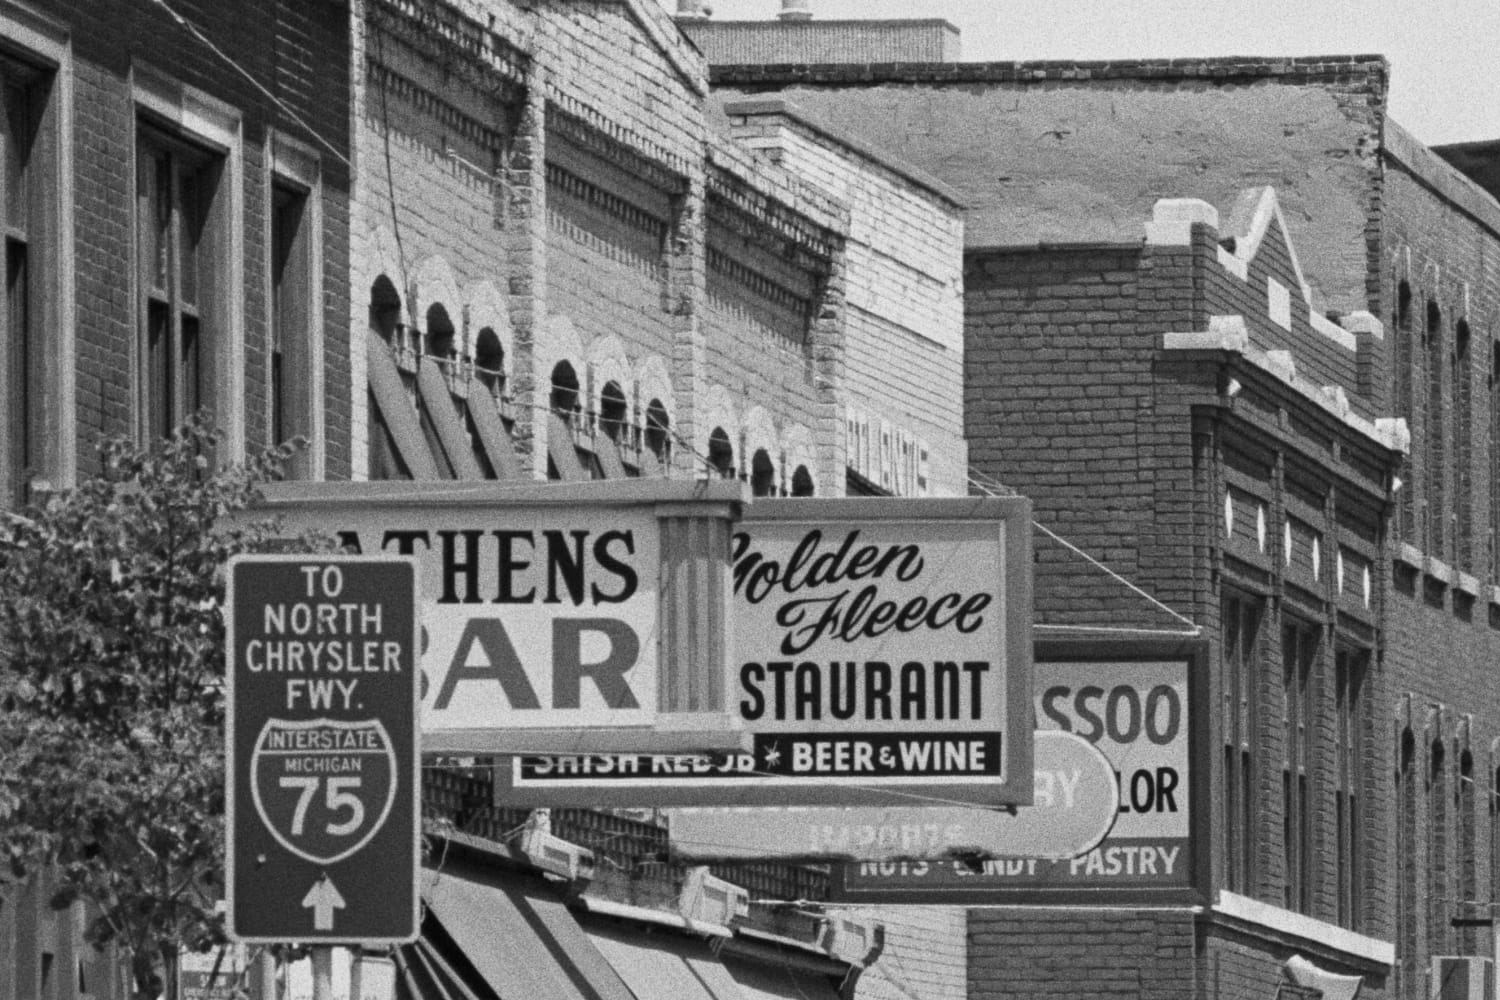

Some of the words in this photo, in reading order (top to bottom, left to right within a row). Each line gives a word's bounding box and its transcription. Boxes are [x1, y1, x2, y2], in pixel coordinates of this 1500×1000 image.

[300, 565, 343, 598] TO
[334, 530, 639, 607] HENS
[263, 603, 382, 635] NORTH
[776, 585, 993, 656] Fleece
[246, 640, 401, 673] CHRYSLER
[421, 617, 641, 711] AR
[286, 678, 363, 710] FWY.
[739, 661, 990, 721] STAURANT
[1036, 684, 1181, 746] SSOO
[267, 729, 378, 749] INTERSTATE
[792, 740, 874, 772] BEER
[879, 745, 896, 767] &
[899, 739, 986, 772] WINE
[285, 757, 362, 773] MICHIGAN
[279, 776, 364, 836] 75
